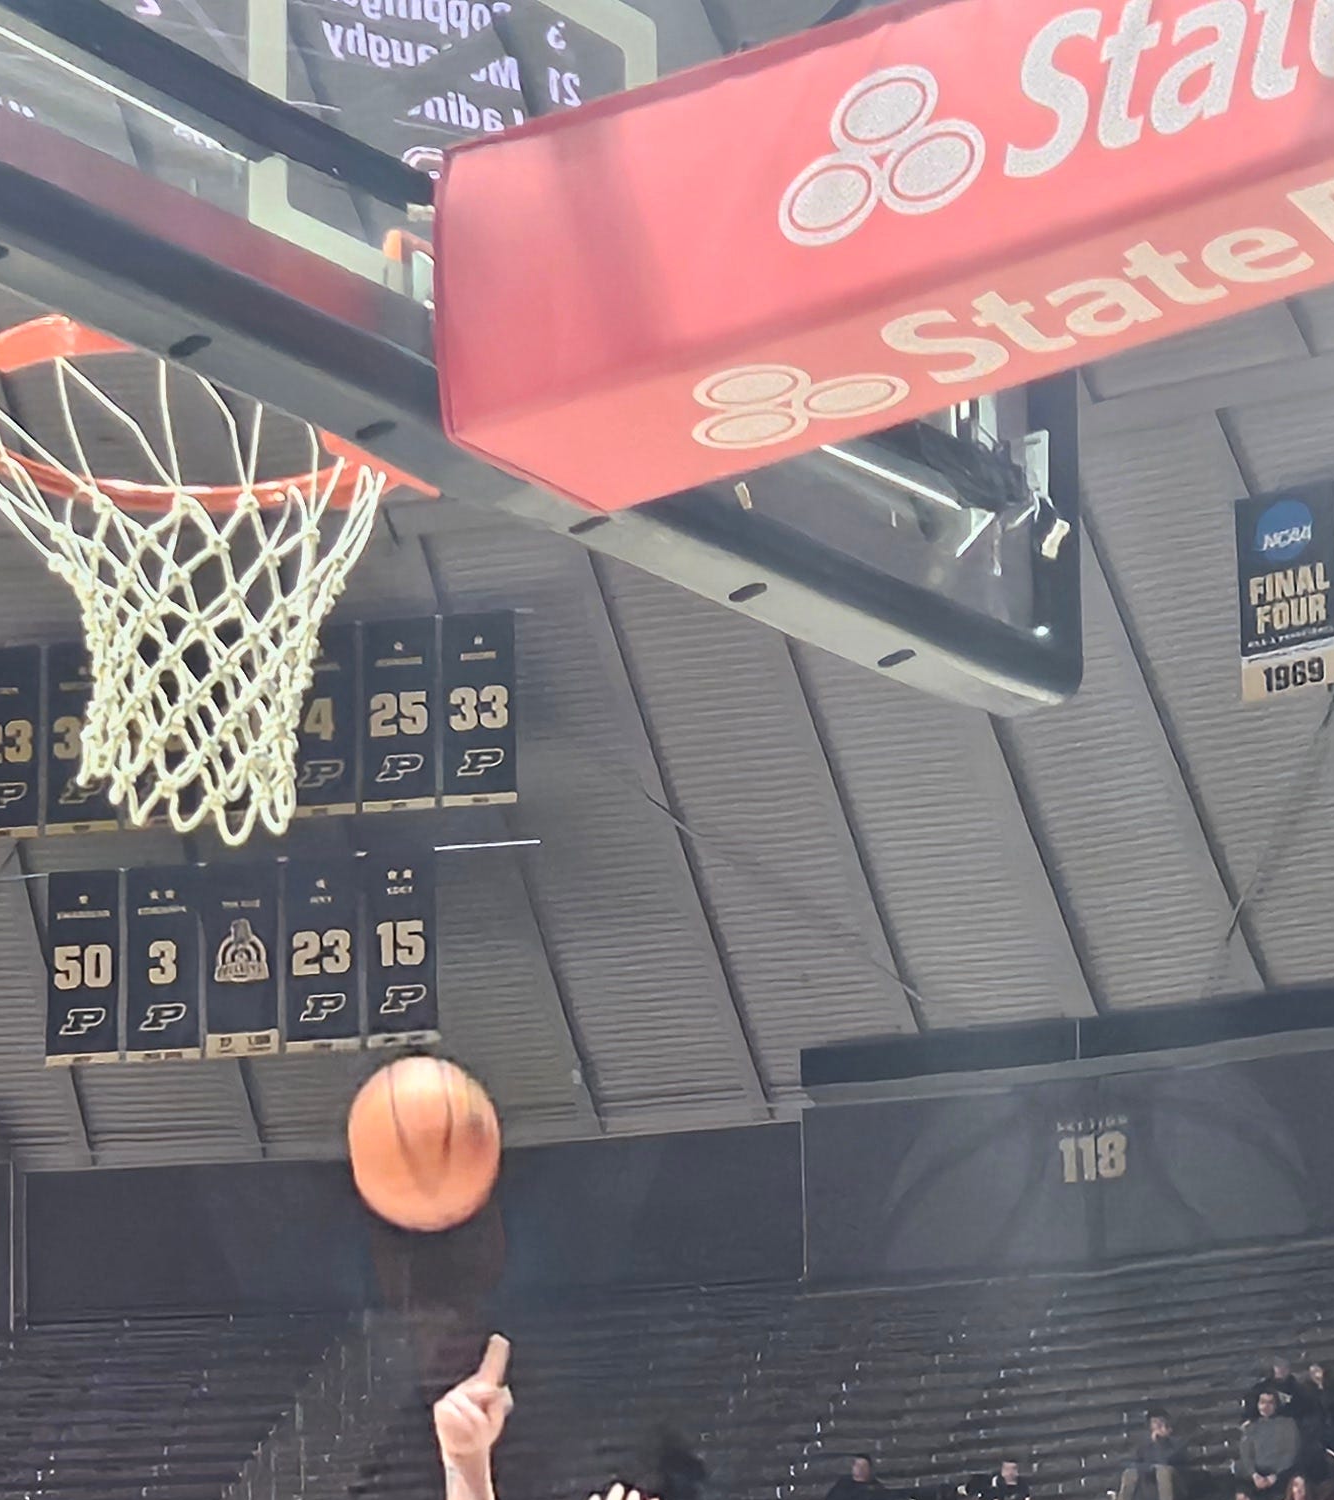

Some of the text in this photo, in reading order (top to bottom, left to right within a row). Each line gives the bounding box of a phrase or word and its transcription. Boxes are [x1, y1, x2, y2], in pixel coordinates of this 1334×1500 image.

[1261, 521, 1313, 551] NCAA
[1249, 562, 1331, 606] FINAL
[1256, 594, 1328, 635] FOUR
[1263, 656, 1326, 693] 1969
[370, 690, 428, 737] 25
[449, 685, 508, 731] 33
[53, 943, 113, 990] 50
[148, 940, 177, 984] 3
[292, 929, 352, 976] 23
[376, 920, 426, 967] 15
[1059, 1130, 1128, 1183] 118
